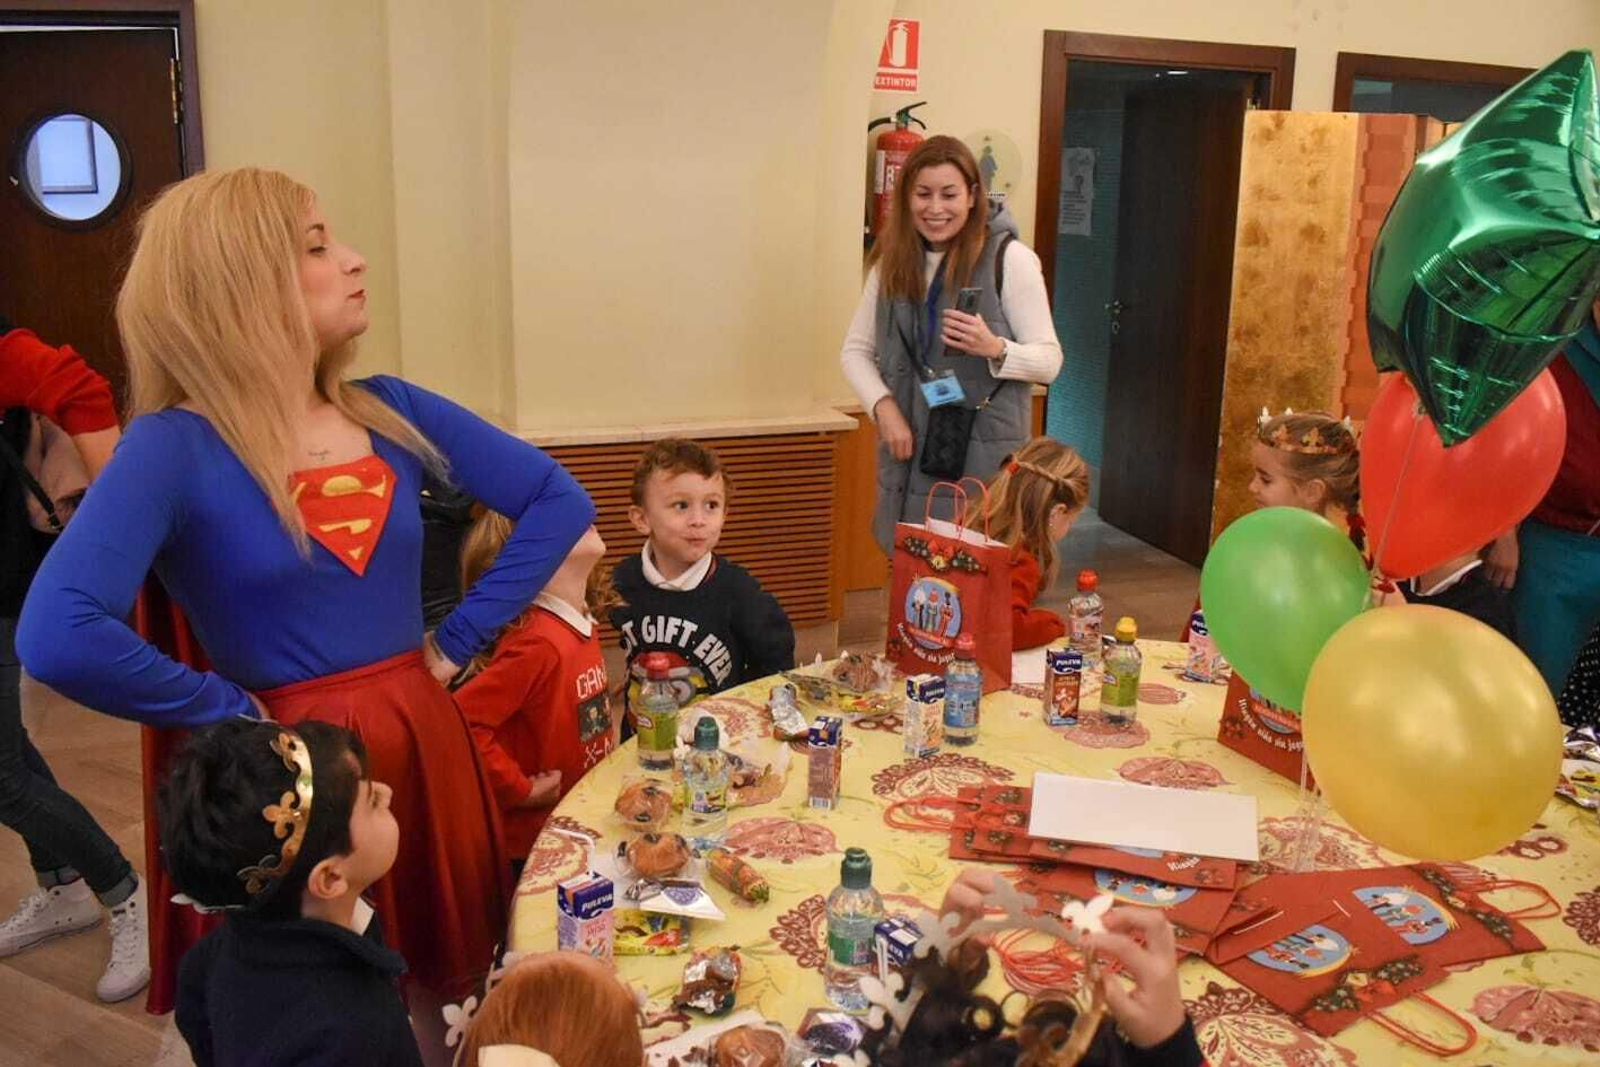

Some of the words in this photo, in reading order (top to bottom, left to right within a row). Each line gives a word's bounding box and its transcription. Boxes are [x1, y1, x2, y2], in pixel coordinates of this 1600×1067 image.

[875, 76, 917, 87] EXTINTOR
[641, 615, 698, 648] GIFT
[1056, 658, 1082, 666] PULEVA
[581, 893, 613, 912] PULEVA
